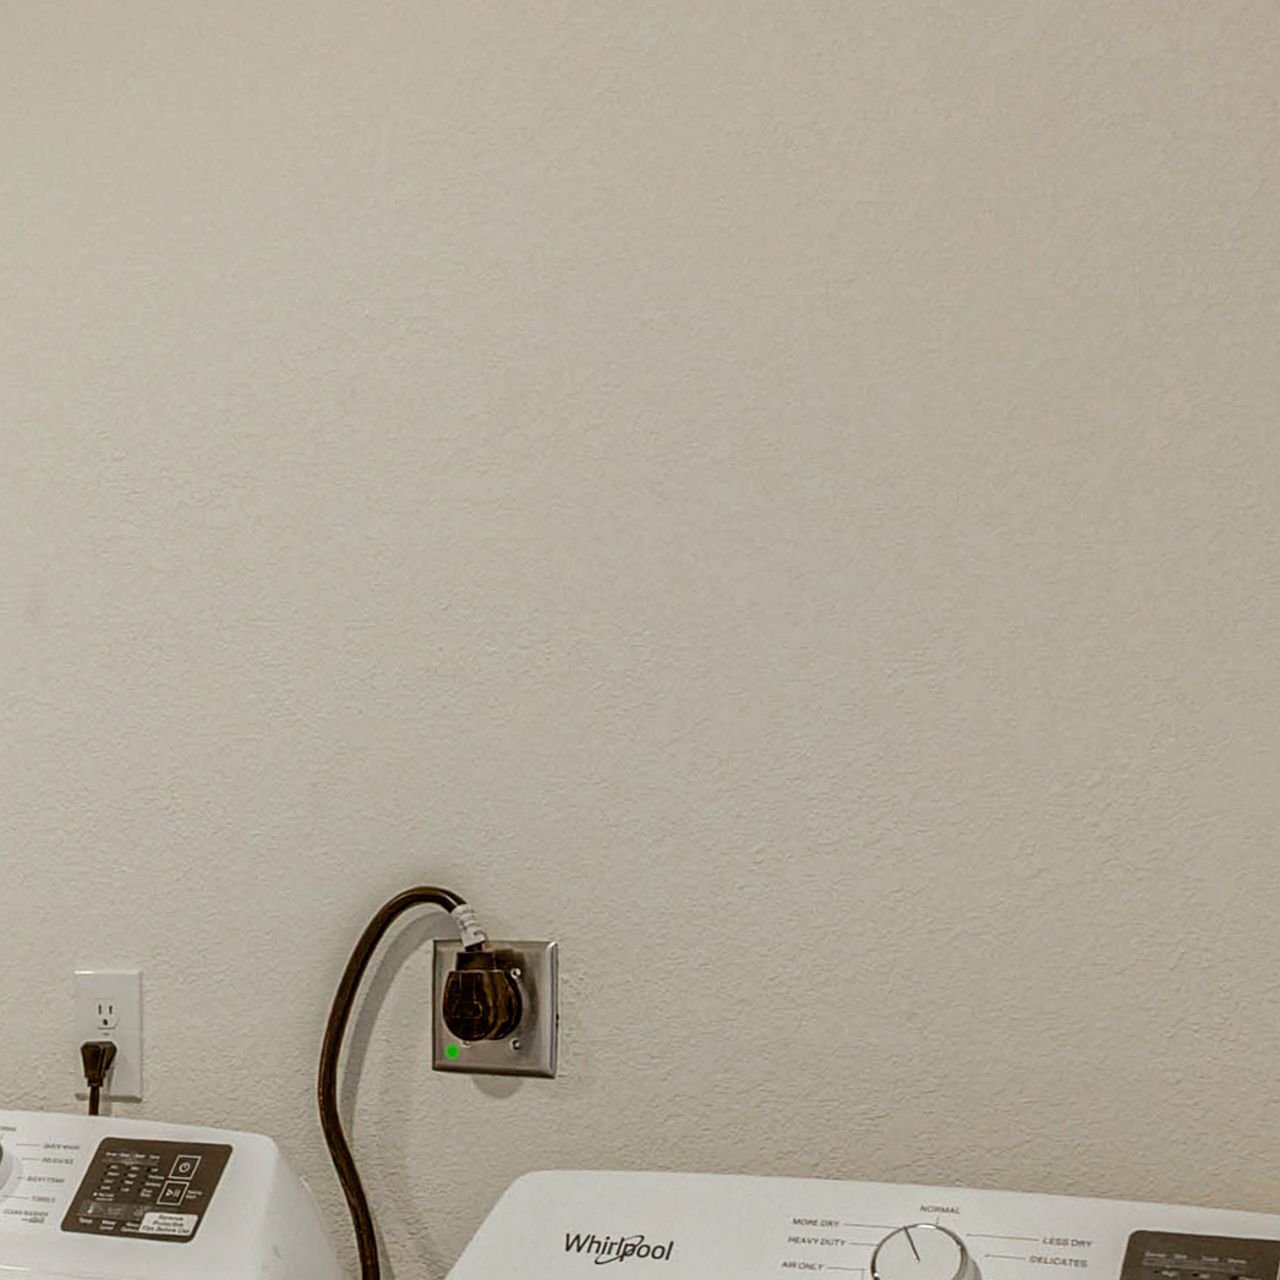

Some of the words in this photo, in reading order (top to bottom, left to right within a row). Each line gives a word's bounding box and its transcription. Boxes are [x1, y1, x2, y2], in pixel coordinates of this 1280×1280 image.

[919, 1204, 961, 1215] NORMAL
[792, 1217, 818, 1227] MORE
[819, 1219, 840, 1228] DRY
[787, 1236, 819, 1246] HEAVY
[820, 1238, 846, 1247] DUTY
[1042, 1237, 1070, 1246] LESS
[1071, 1239, 1094, 1248] DRY
[564, 1232, 674, 1265] Whirlpool
[781, 1261, 797, 1270] AIR
[798, 1262, 825, 1271] ONLY
[1029, 1255, 1088, 1268] DELICATES
